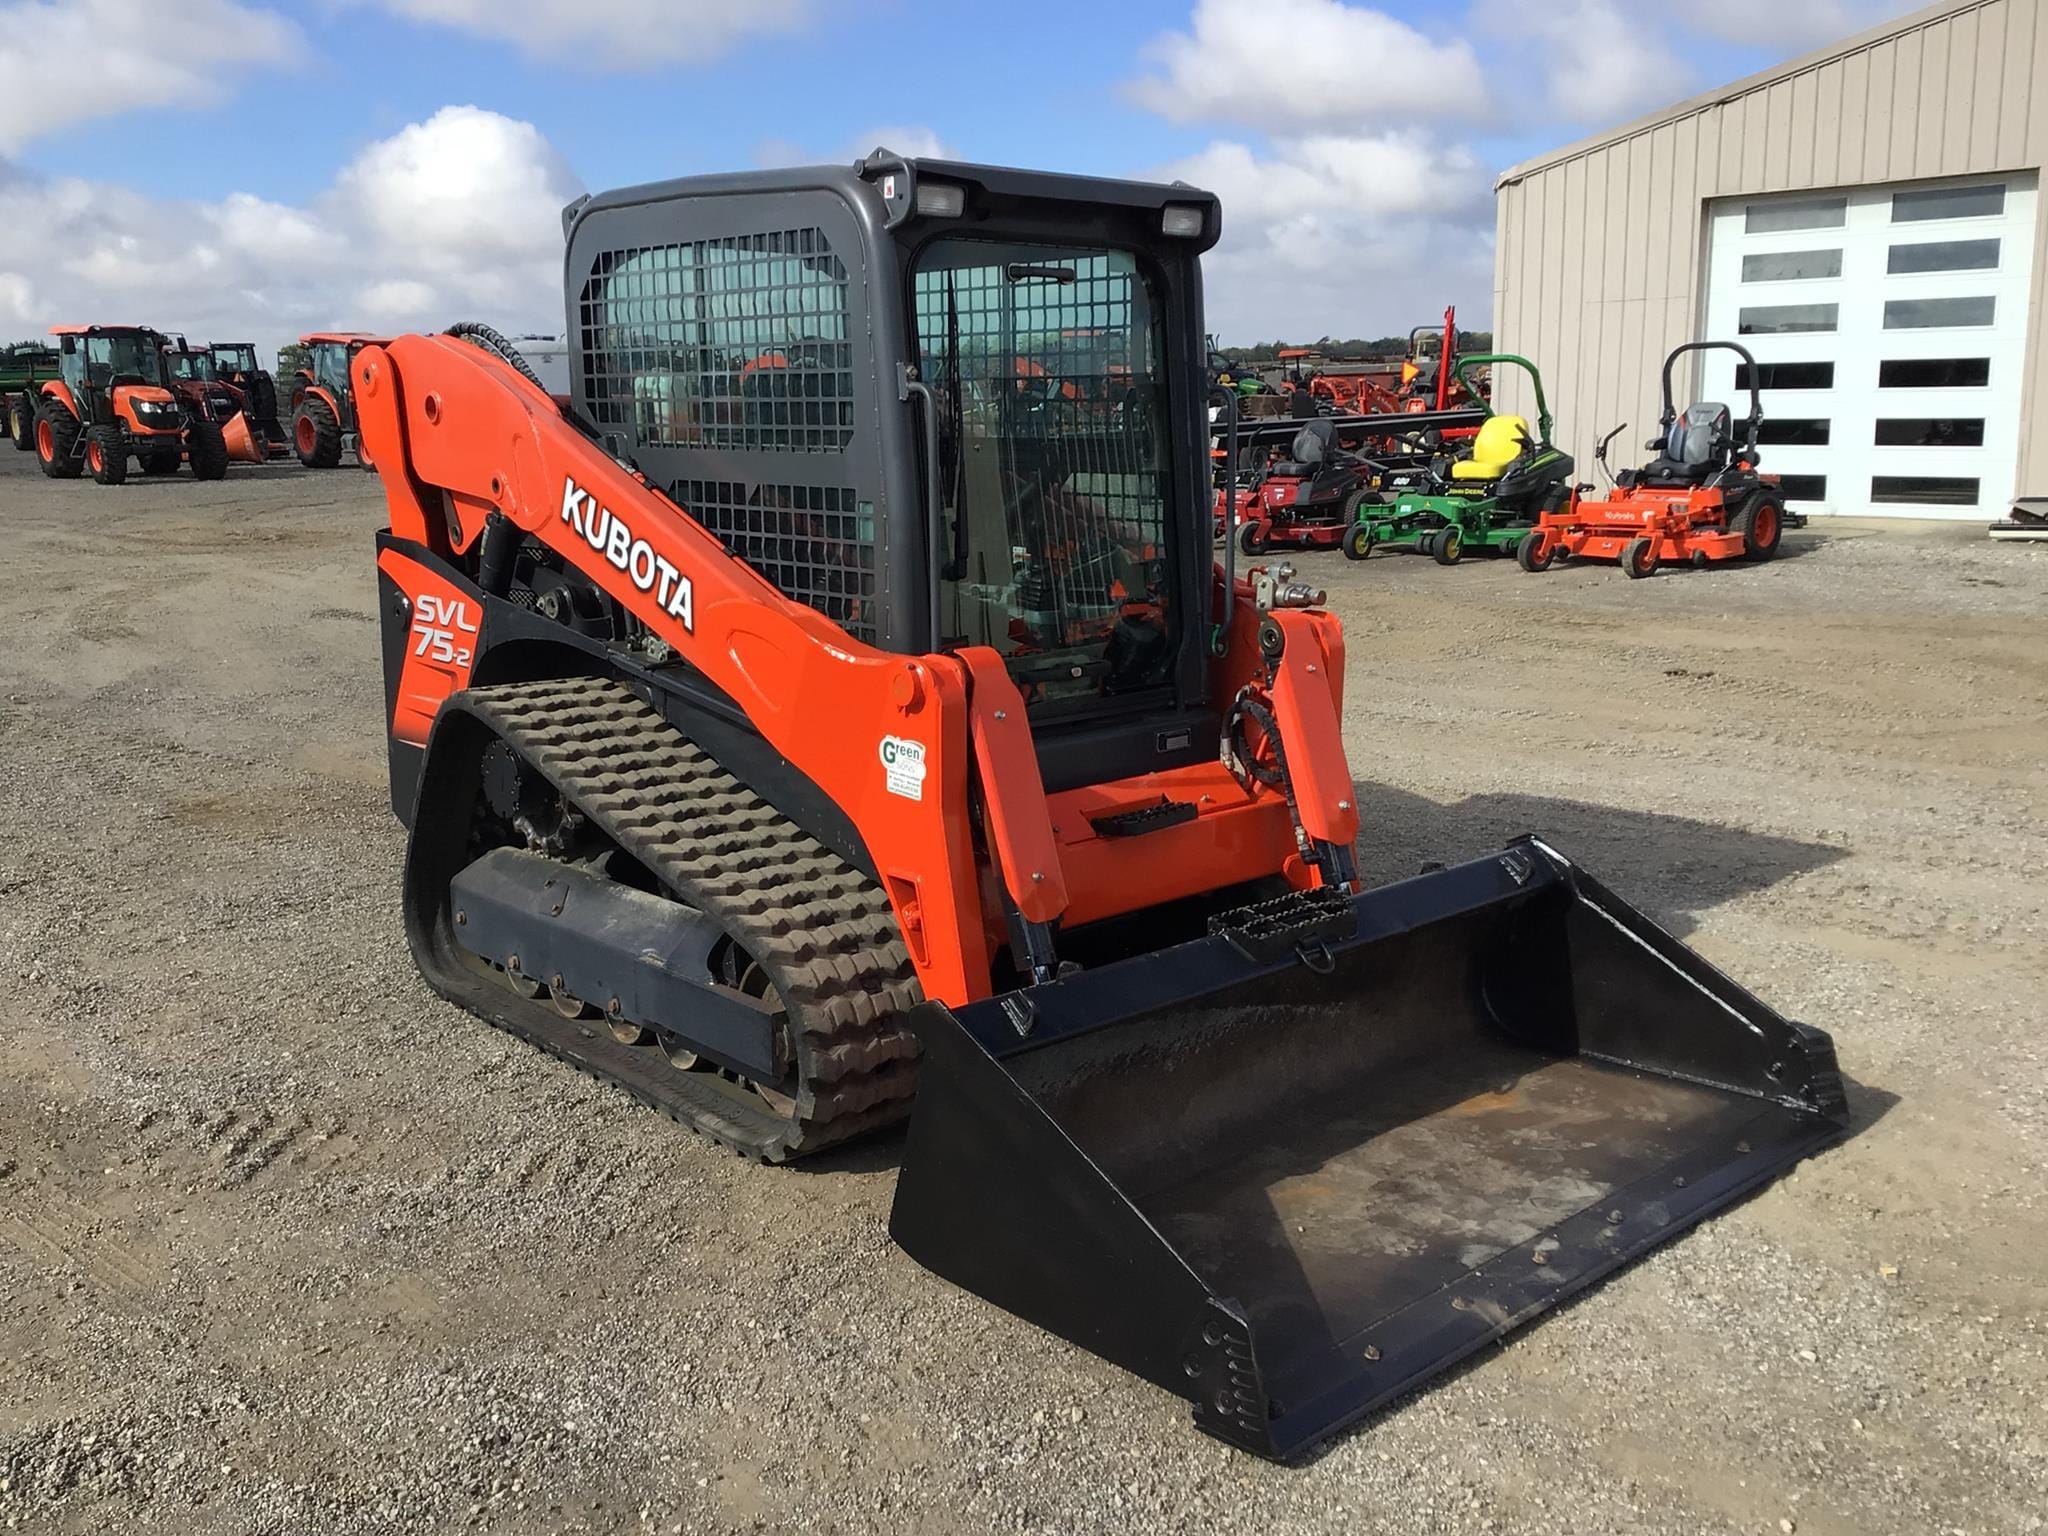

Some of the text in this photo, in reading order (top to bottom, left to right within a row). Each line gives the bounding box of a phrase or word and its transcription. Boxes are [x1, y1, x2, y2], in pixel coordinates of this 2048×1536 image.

[561, 475, 693, 632] KUBOTA
[415, 594, 477, 633] SVL
[883, 741, 920, 764] Green
